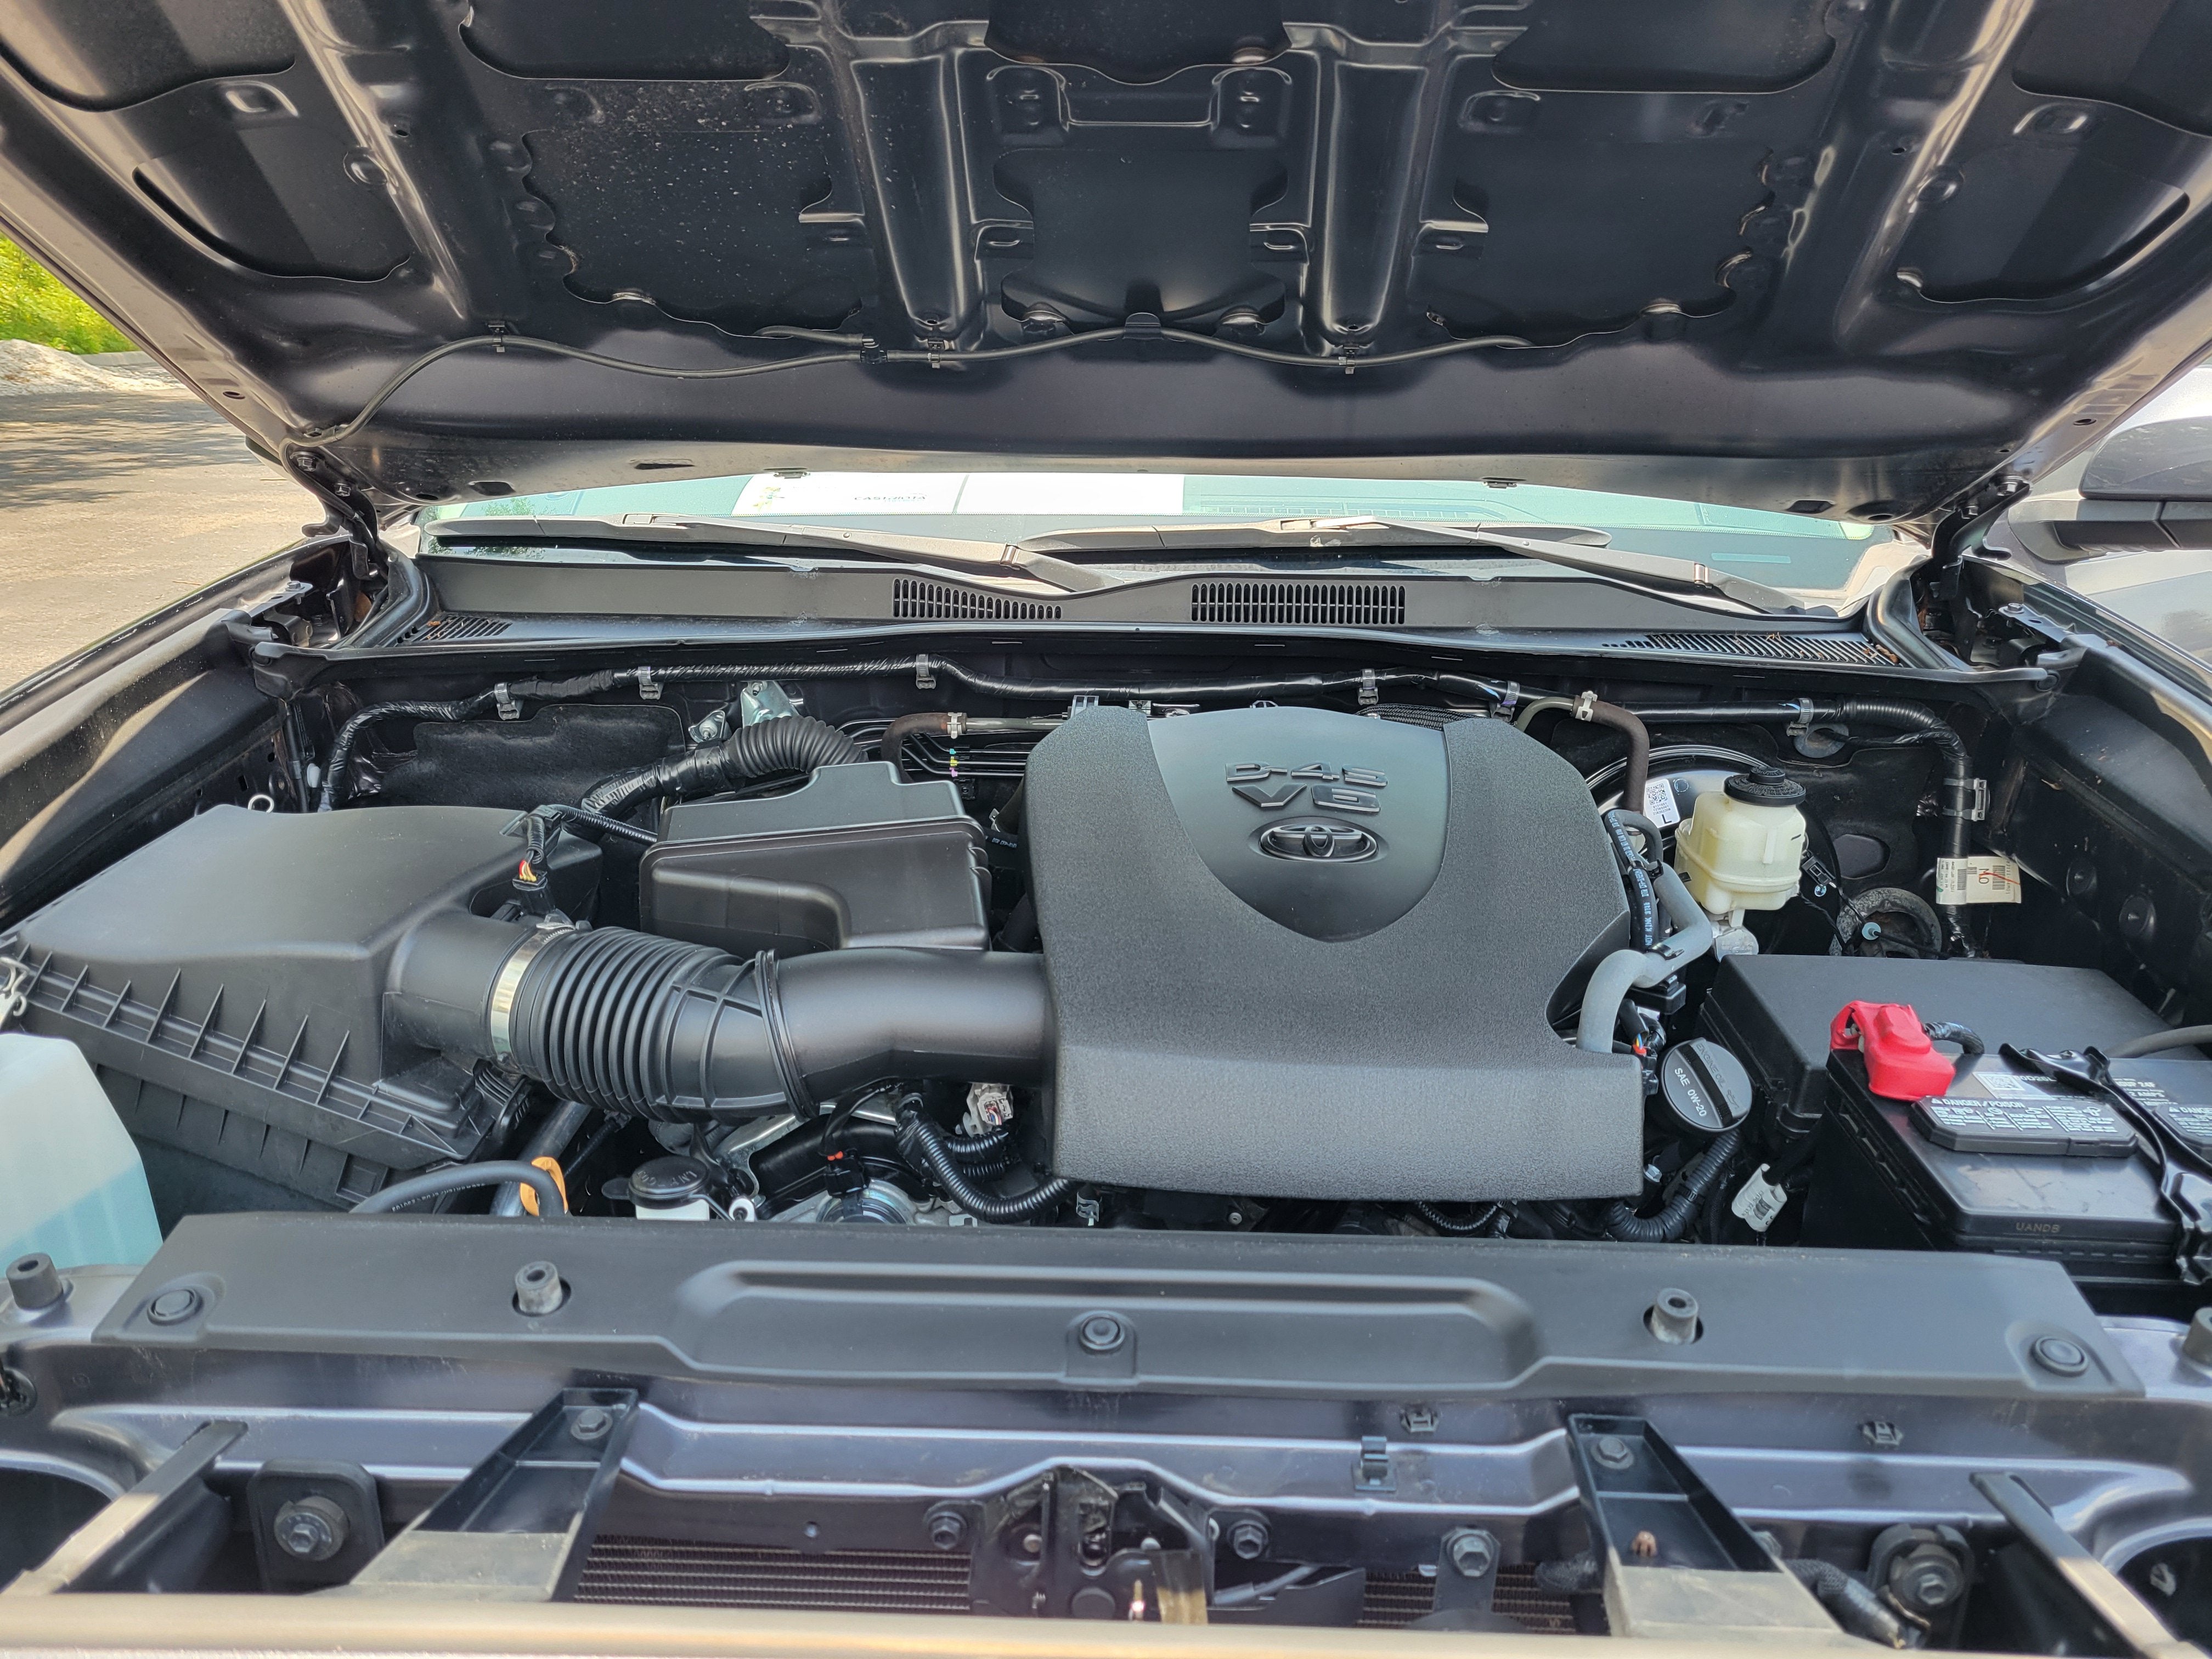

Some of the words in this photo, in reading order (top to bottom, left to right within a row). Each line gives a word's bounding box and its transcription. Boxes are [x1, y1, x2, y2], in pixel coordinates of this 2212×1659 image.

[1232, 782, 1382, 812] V6
[1662, 814, 1673, 824] L
[1696, 1043, 1718, 1074] ENGINE
[1715, 1074, 1726, 1088] OIL
[1674, 1068, 1690, 1087] SAE
[1687, 1089, 1707, 1116] 0W-20
[1942, 1098, 1982, 1107] DANGER
